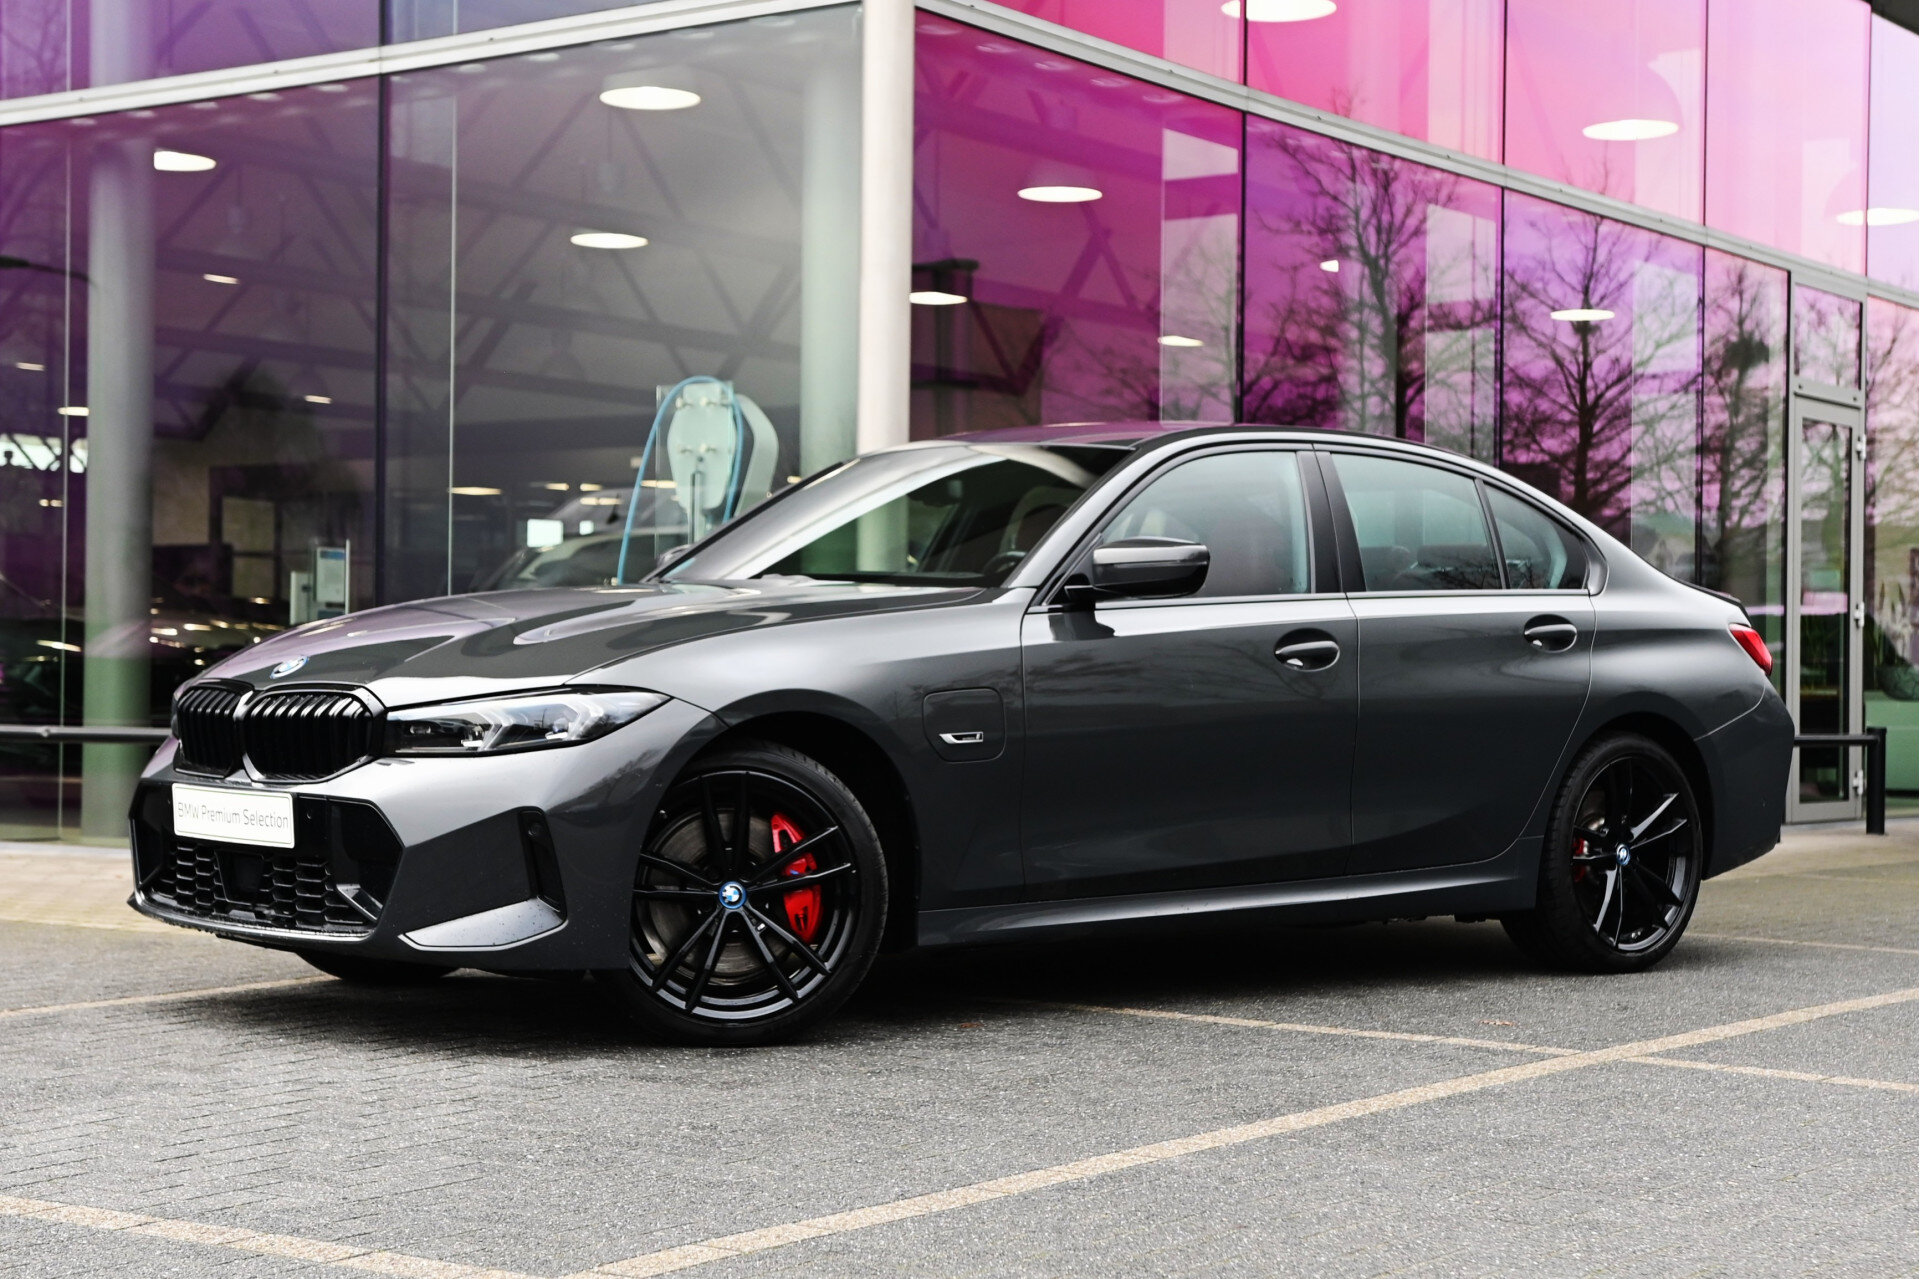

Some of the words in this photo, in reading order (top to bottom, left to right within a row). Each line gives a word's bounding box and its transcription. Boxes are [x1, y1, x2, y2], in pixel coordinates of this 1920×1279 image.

[178, 802, 199, 819] BMW
[201, 804, 240, 824] Premium
[243, 808, 289, 829] Selection
